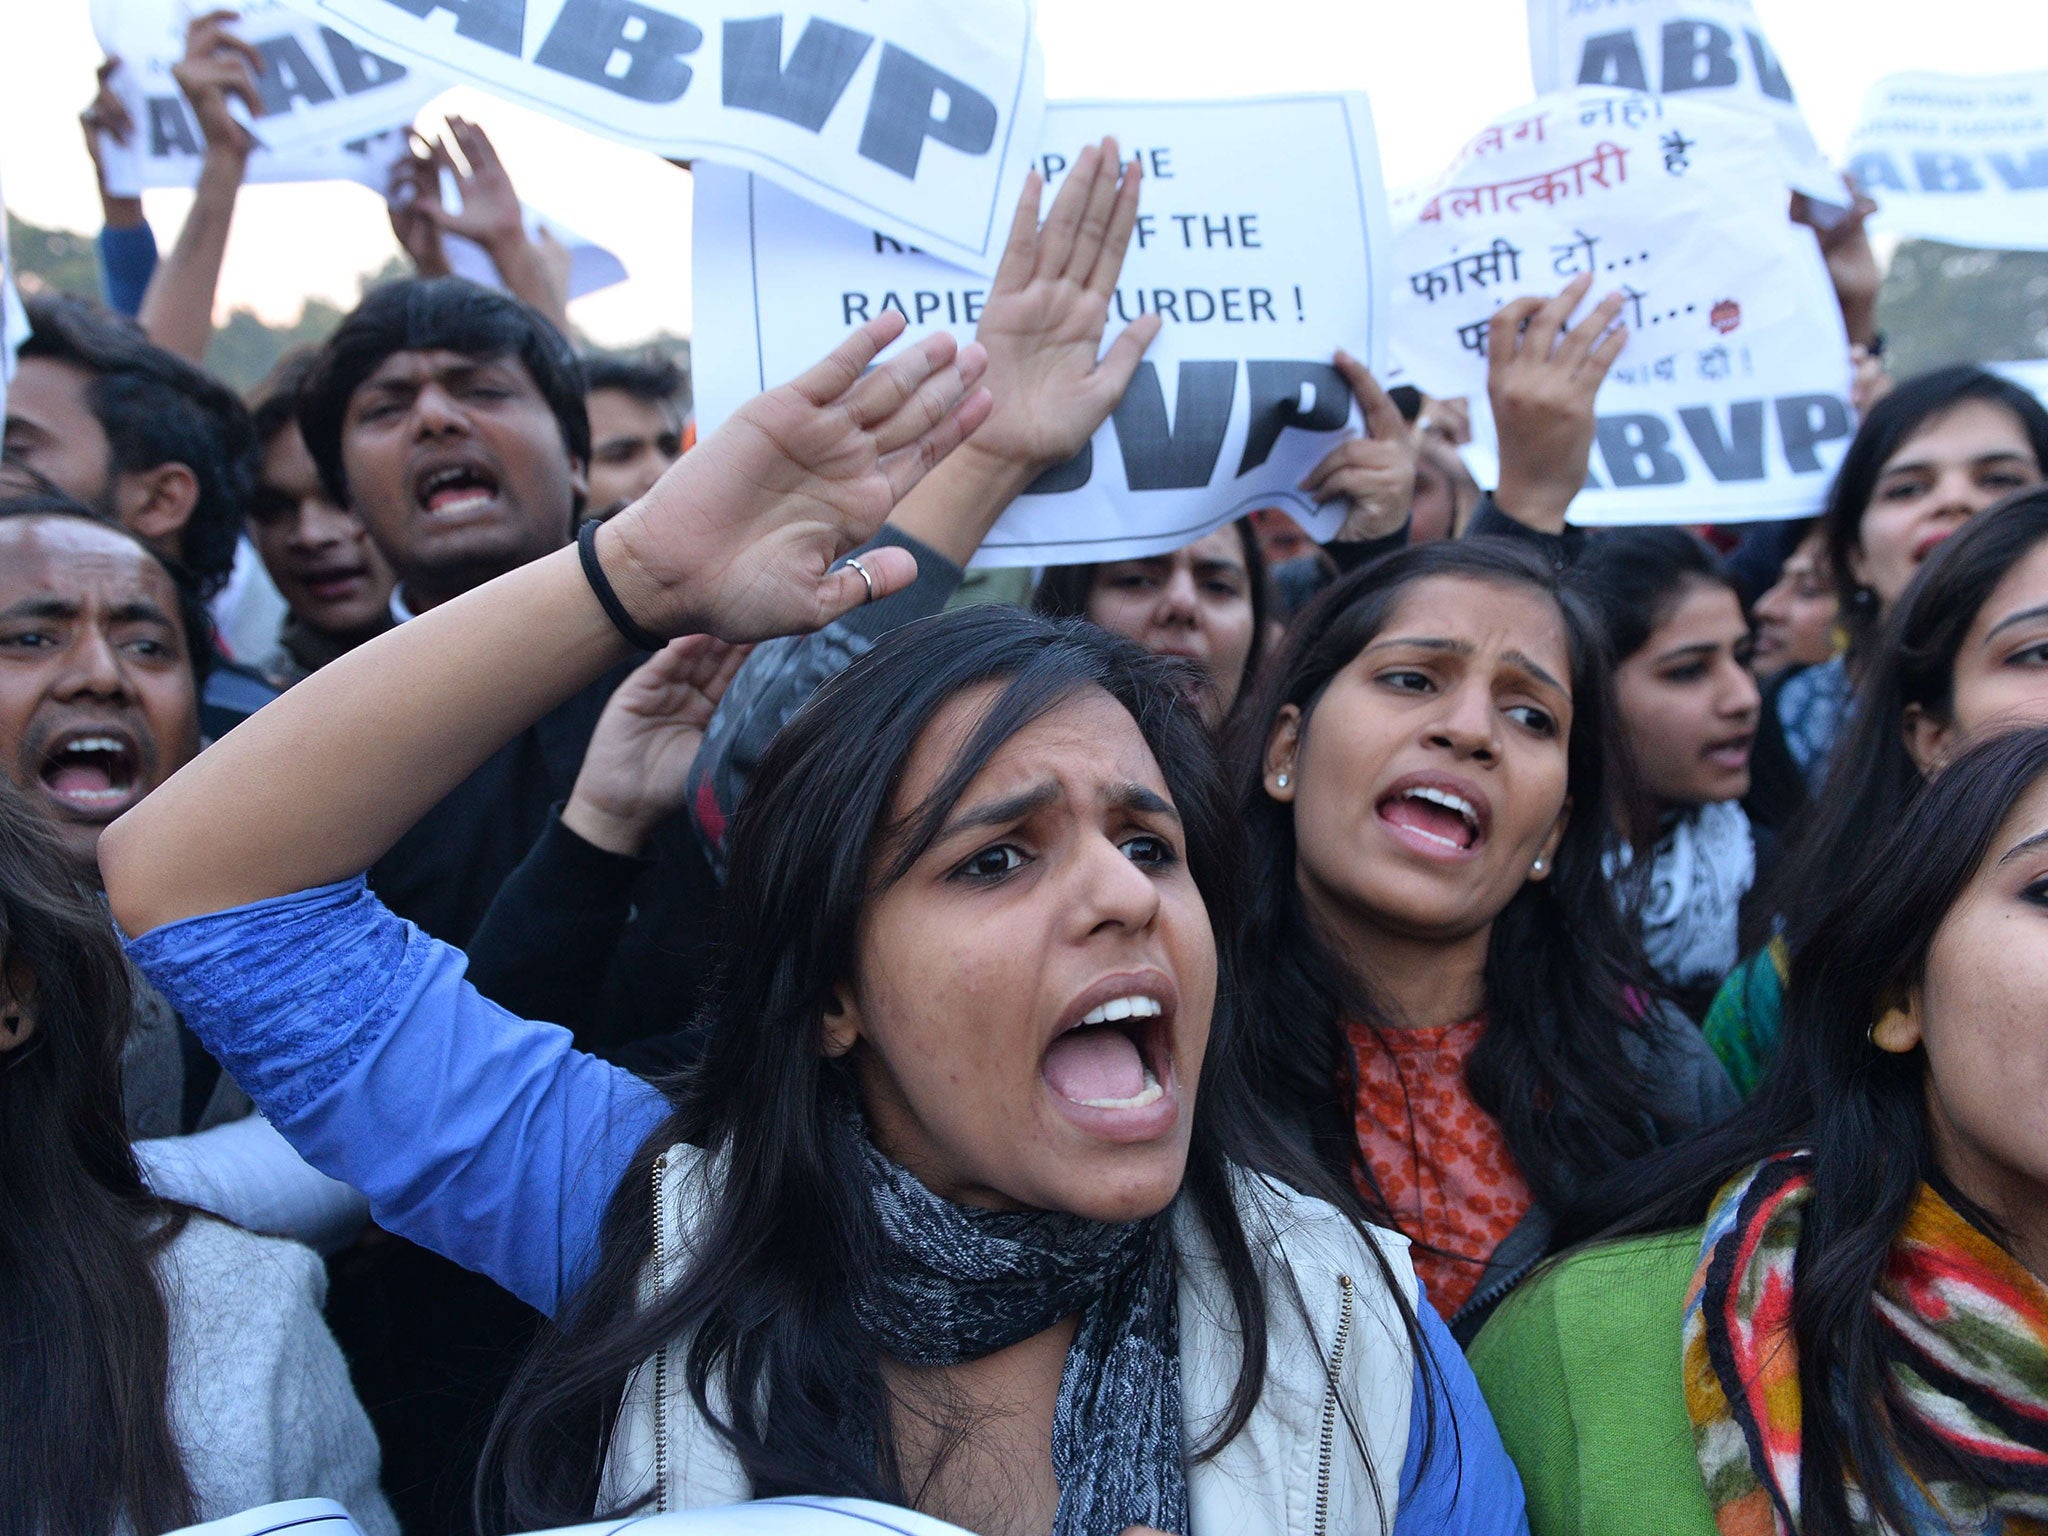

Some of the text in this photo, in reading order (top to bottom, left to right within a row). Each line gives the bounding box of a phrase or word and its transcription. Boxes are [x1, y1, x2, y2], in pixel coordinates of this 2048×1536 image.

[1172, 214, 1262, 248] THE
[842, 285, 1304, 325] RAPIE URDER !
